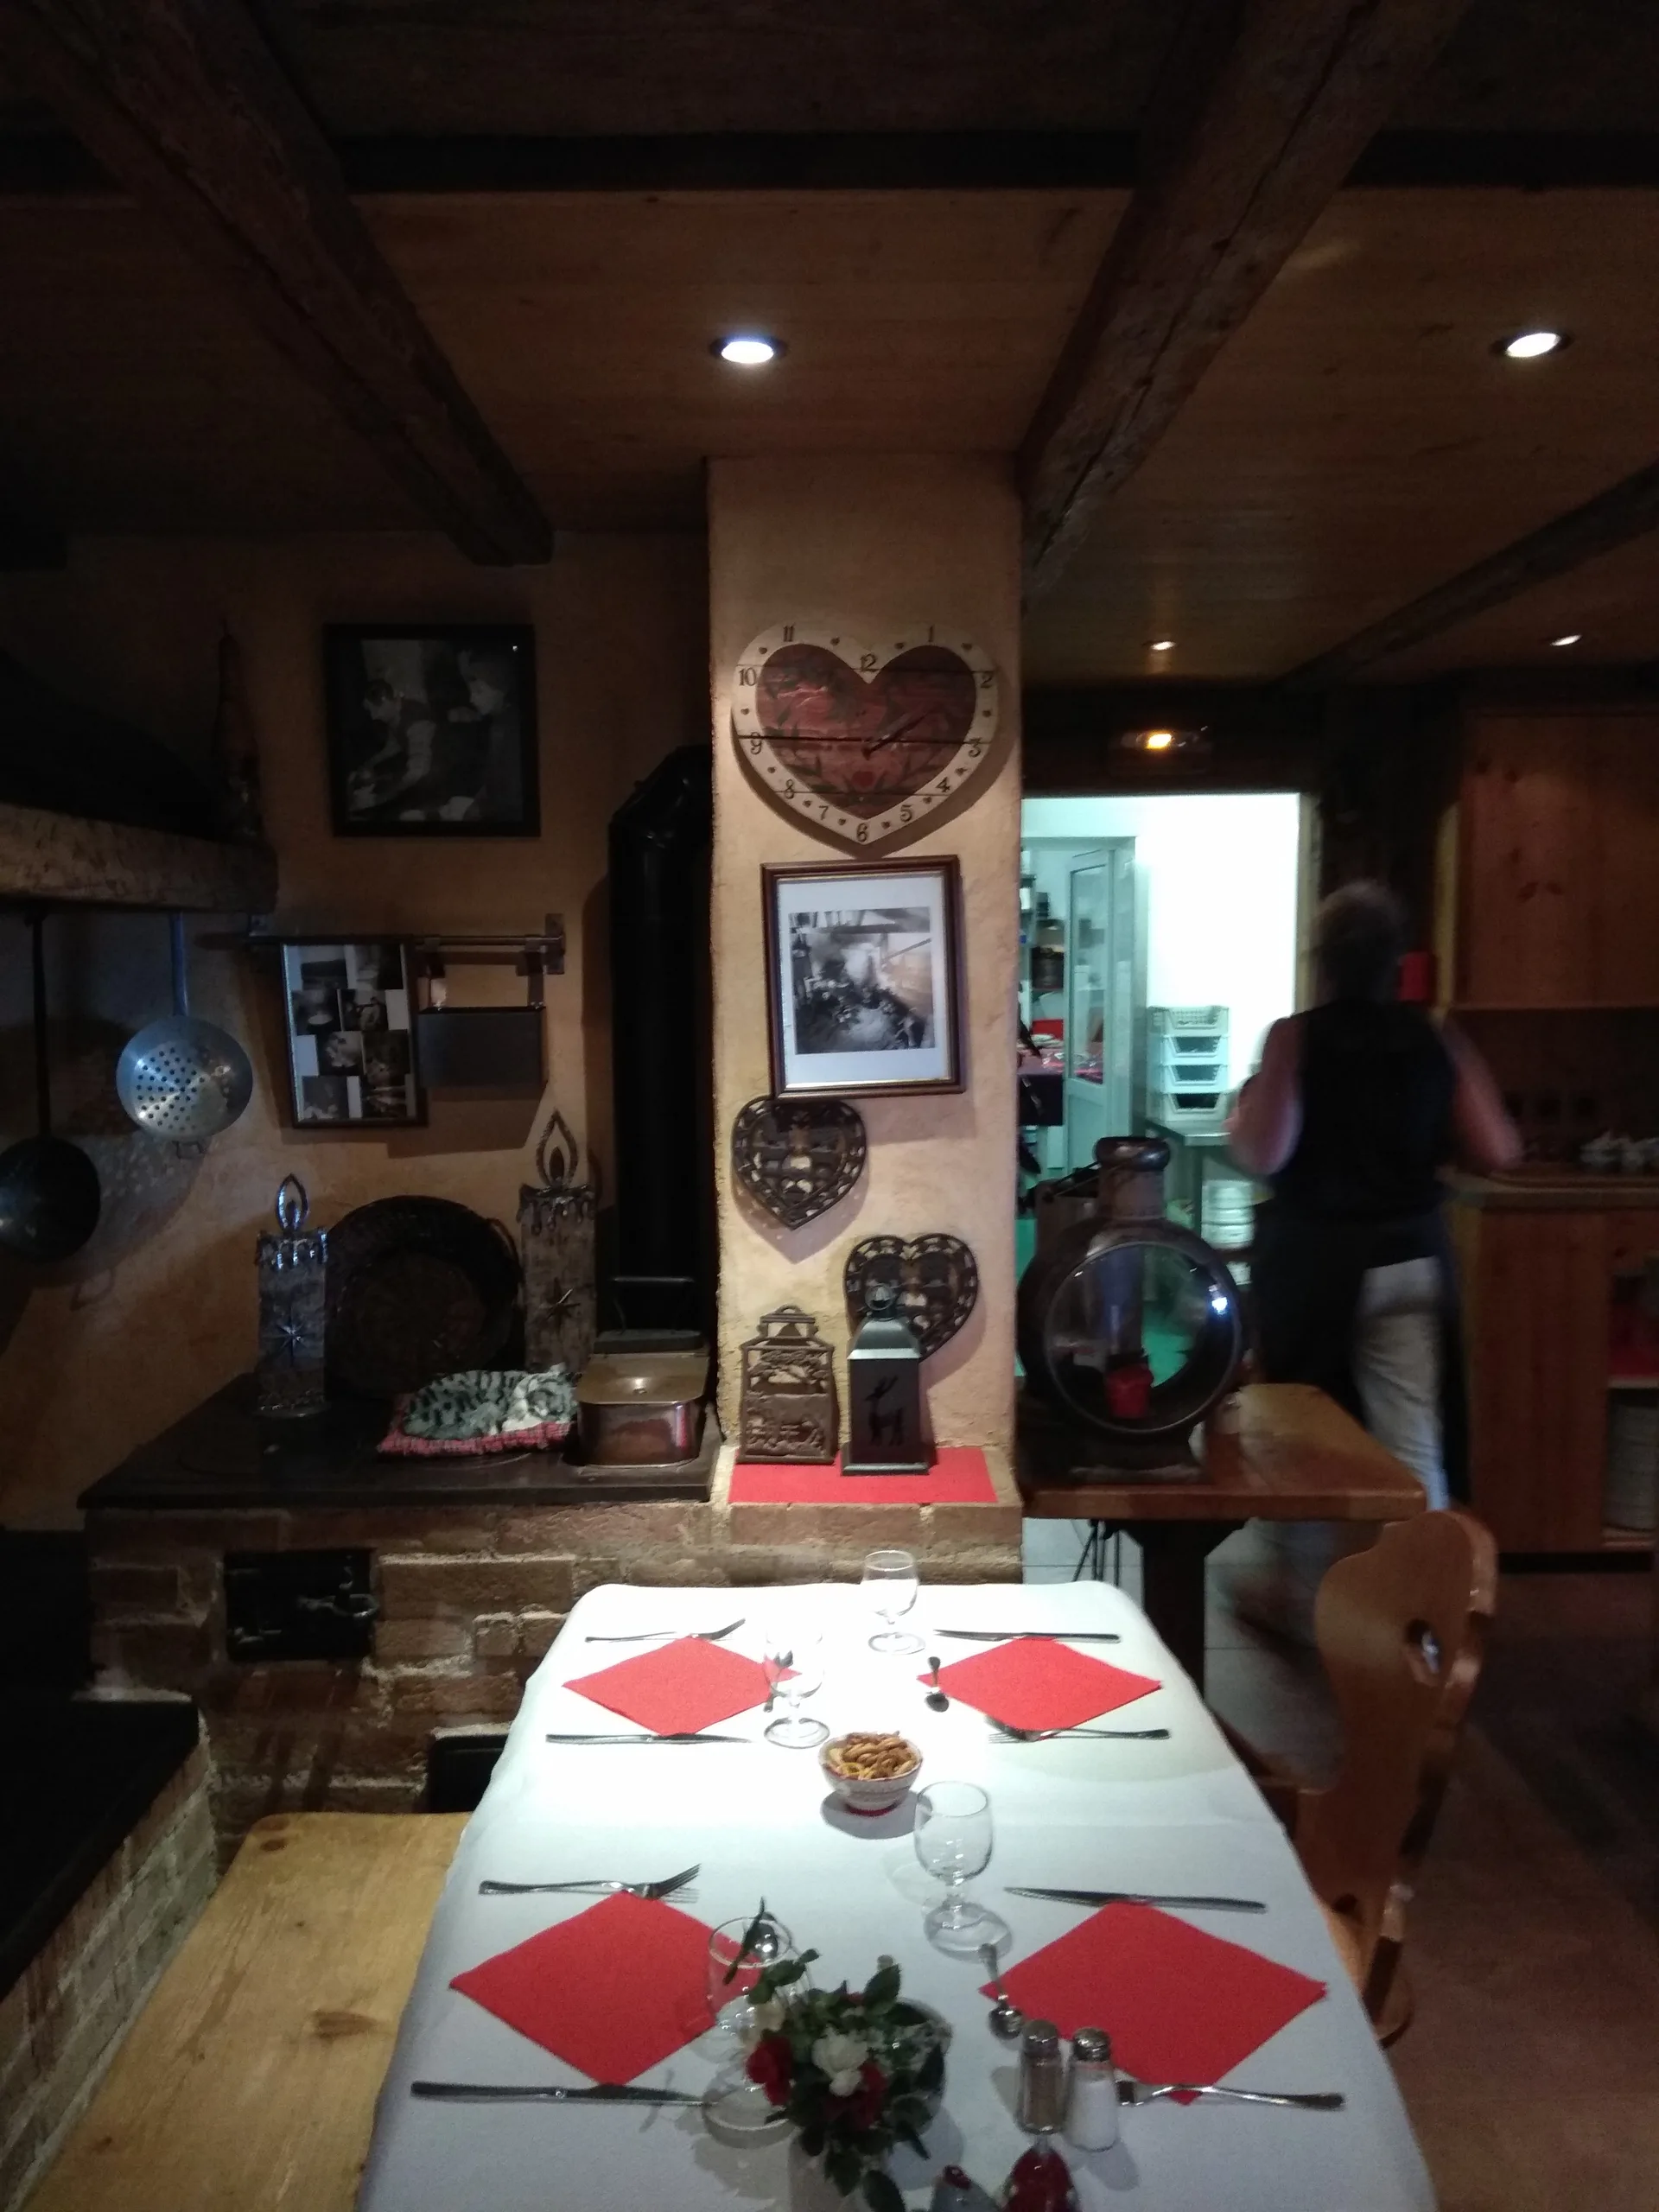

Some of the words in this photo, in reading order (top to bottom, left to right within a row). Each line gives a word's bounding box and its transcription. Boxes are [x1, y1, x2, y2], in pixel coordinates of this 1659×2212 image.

[782, 625, 796, 642] 11
[860, 653, 879, 672] 12
[739, 667, 757, 687] 10
[979, 671, 994, 689] 2
[749, 732, 762, 754] 9
[967, 737, 983, 757] 3
[784, 779, 796, 799] 8
[935, 779, 951, 794] 4
[818, 804, 830, 821] 7
[900, 804, 915, 822] 5
[855, 823, 868, 842] 6
